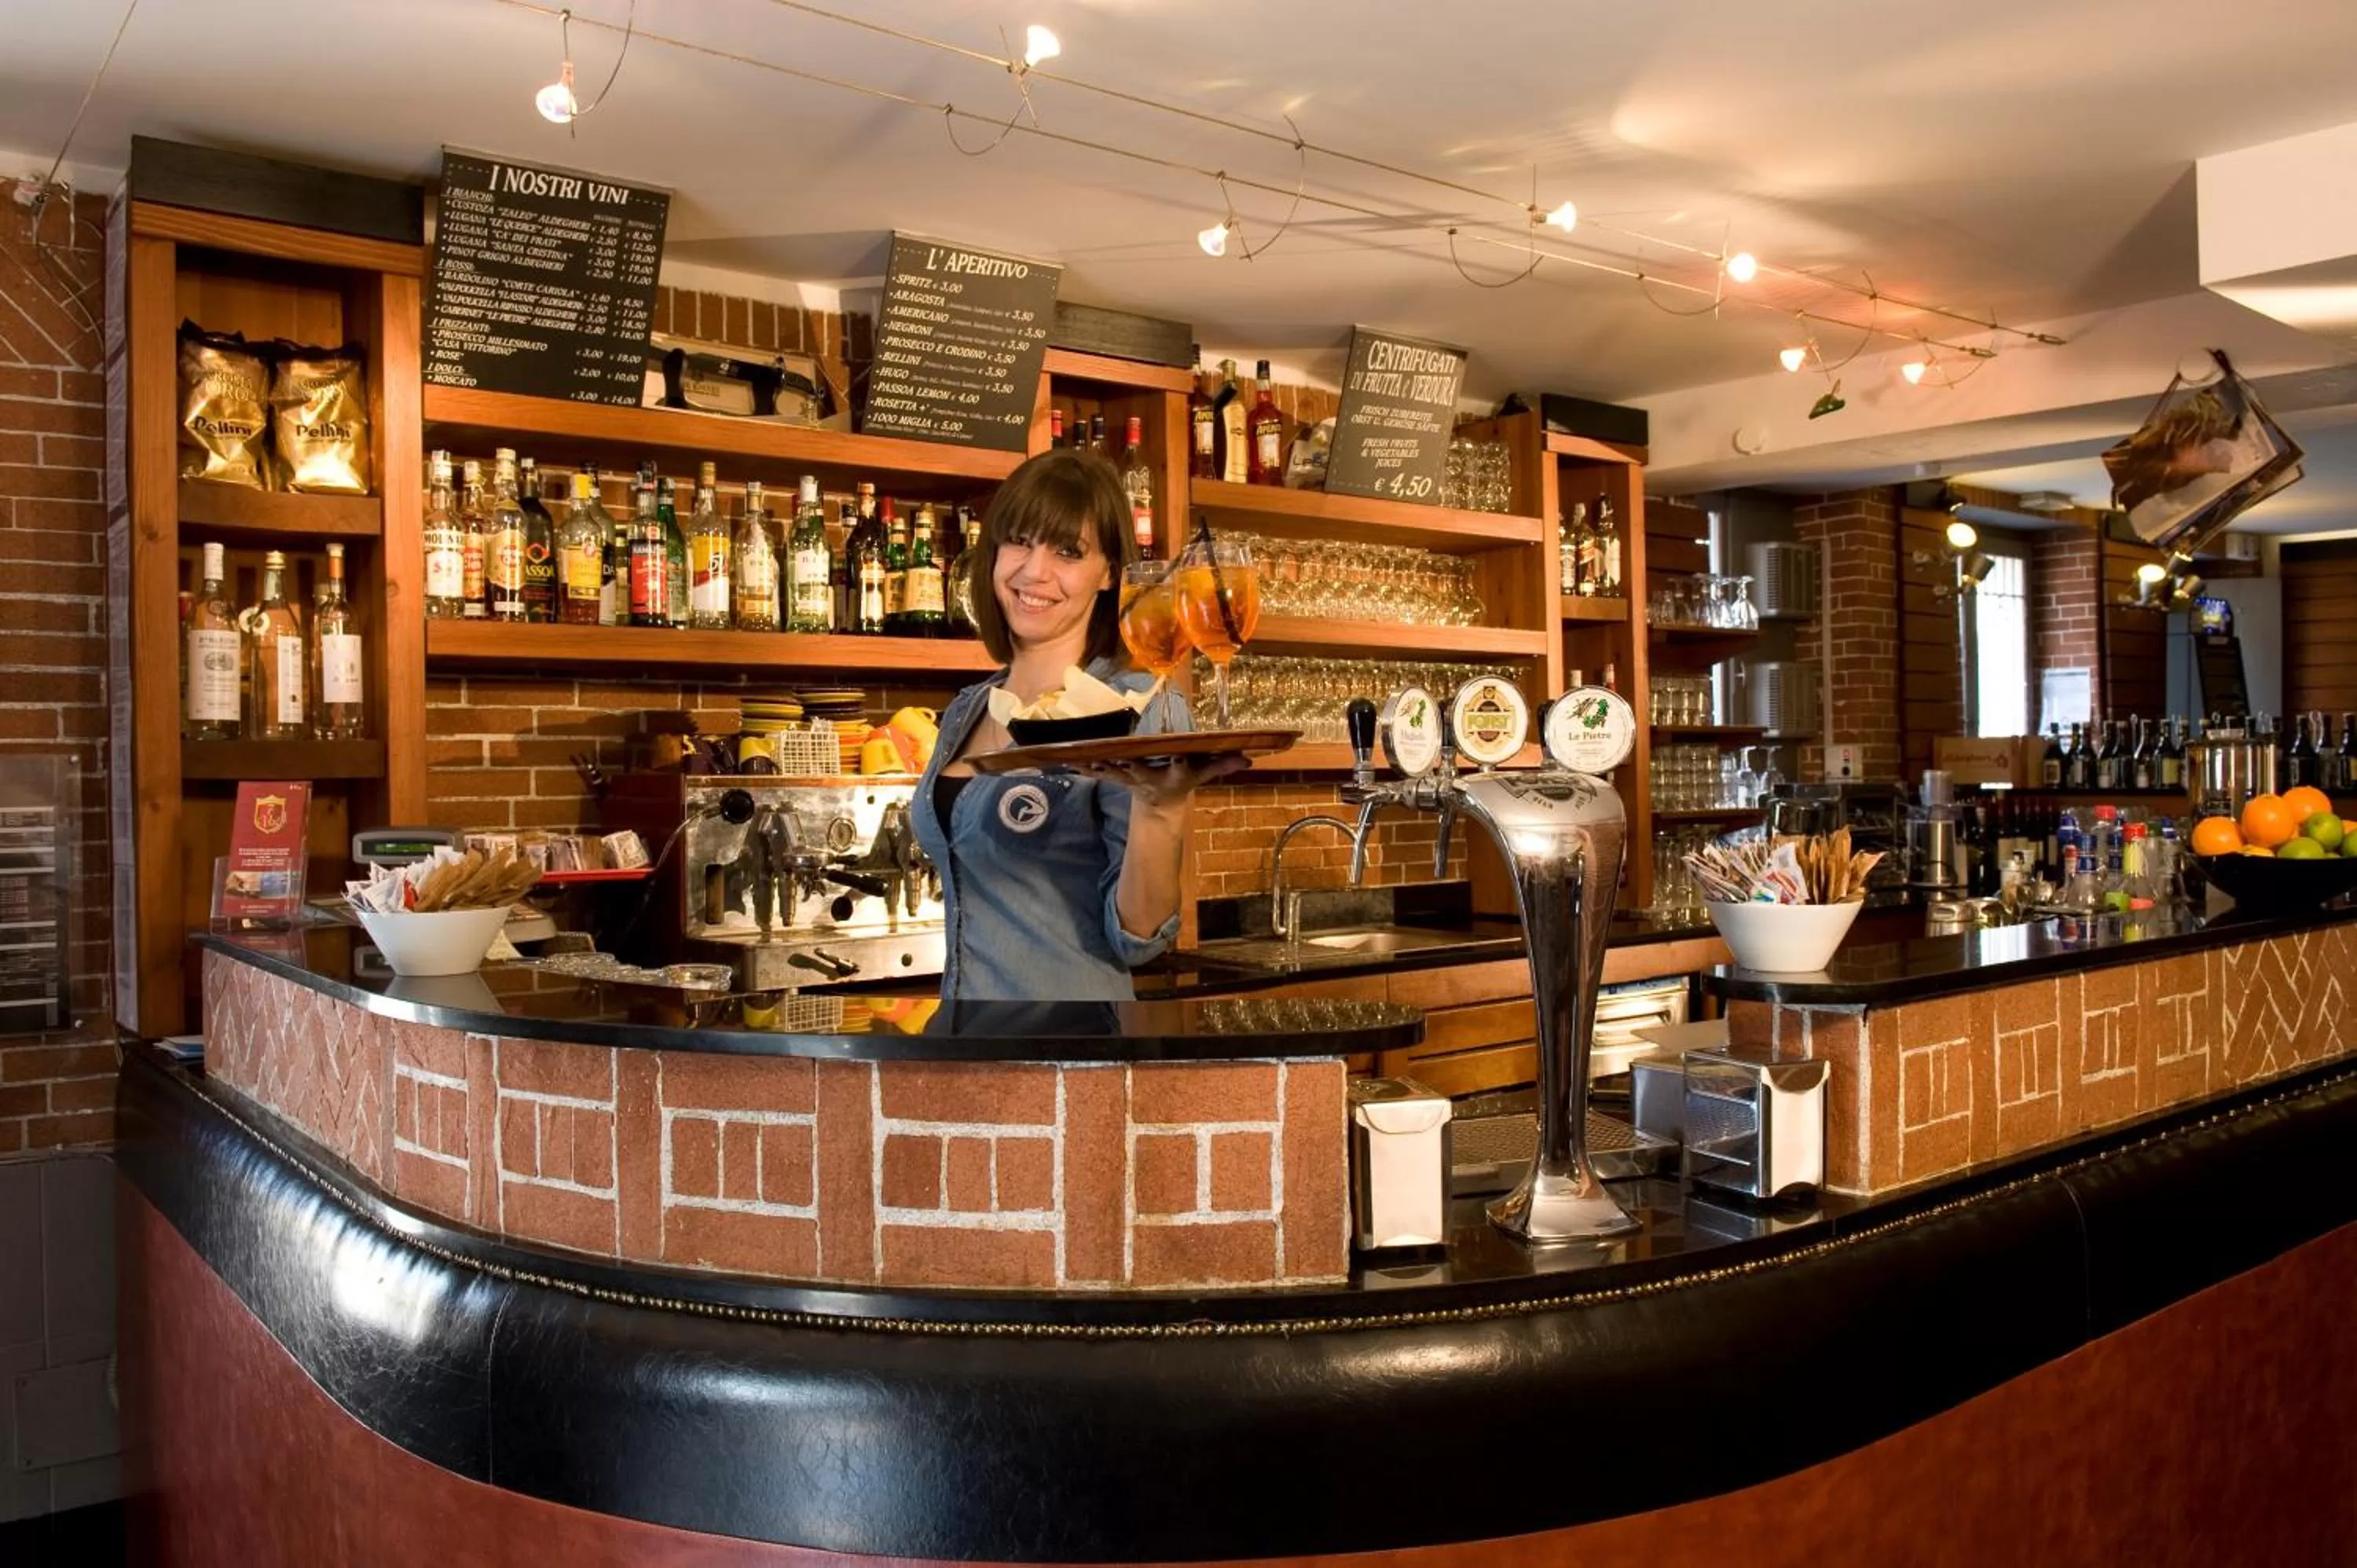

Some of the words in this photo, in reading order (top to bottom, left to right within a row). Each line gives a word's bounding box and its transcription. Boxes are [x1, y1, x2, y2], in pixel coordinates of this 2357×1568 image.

[489, 165, 500, 190] I
[503, 167, 583, 200] NOSTRI
[588, 182, 629, 204] VINI
[452, 200, 494, 214] CUSTOZA
[450, 211, 486, 225] LUGANA
[448, 234, 486, 247] LUGANA
[449, 223, 488, 236] LUGANA
[511, 233, 528, 243] DEI
[446, 245, 477, 258] PINOT
[477, 251, 511, 262] GRIGIO
[511, 256, 565, 271] ALDEGHERI
[926, 247, 945, 270] L'
[944, 252, 1028, 279] APERITIVO
[444, 271, 499, 286] BARDOLINO
[896, 273, 933, 289] SPRITZ
[893, 289, 945, 307] ARAGOSTA
[890, 305, 950, 323] AMERICANO
[887, 321, 933, 336] NEGRONI
[438, 330, 486, 343] PROSECCO
[487, 335, 548, 351] MILLESIMATO
[885, 335, 936, 351] PROSECCO
[936, 343, 944, 353] E
[944, 345, 988, 360] CRODINO
[882, 351, 922, 365] BELLINI
[1368, 339, 1457, 374] CENTRIFUGATI
[879, 366, 910, 379] HUGO
[433, 375, 478, 387] MOSCATO
[877, 381, 914, 396] PASSOA
[916, 387, 952, 401] LEMON
[1362, 372, 1402, 397] FRUTTA
[1409, 375, 1457, 407] VERDURA
[874, 397, 918, 412] ROSETTA
[1361, 405, 1390, 416] FRISCH
[873, 412, 898, 424] 1000
[899, 415, 933, 428] MIGLIA
[1362, 438, 1390, 448] FRESH
[1374, 477, 1386, 492] €
[1389, 472, 1432, 497] 4,50
